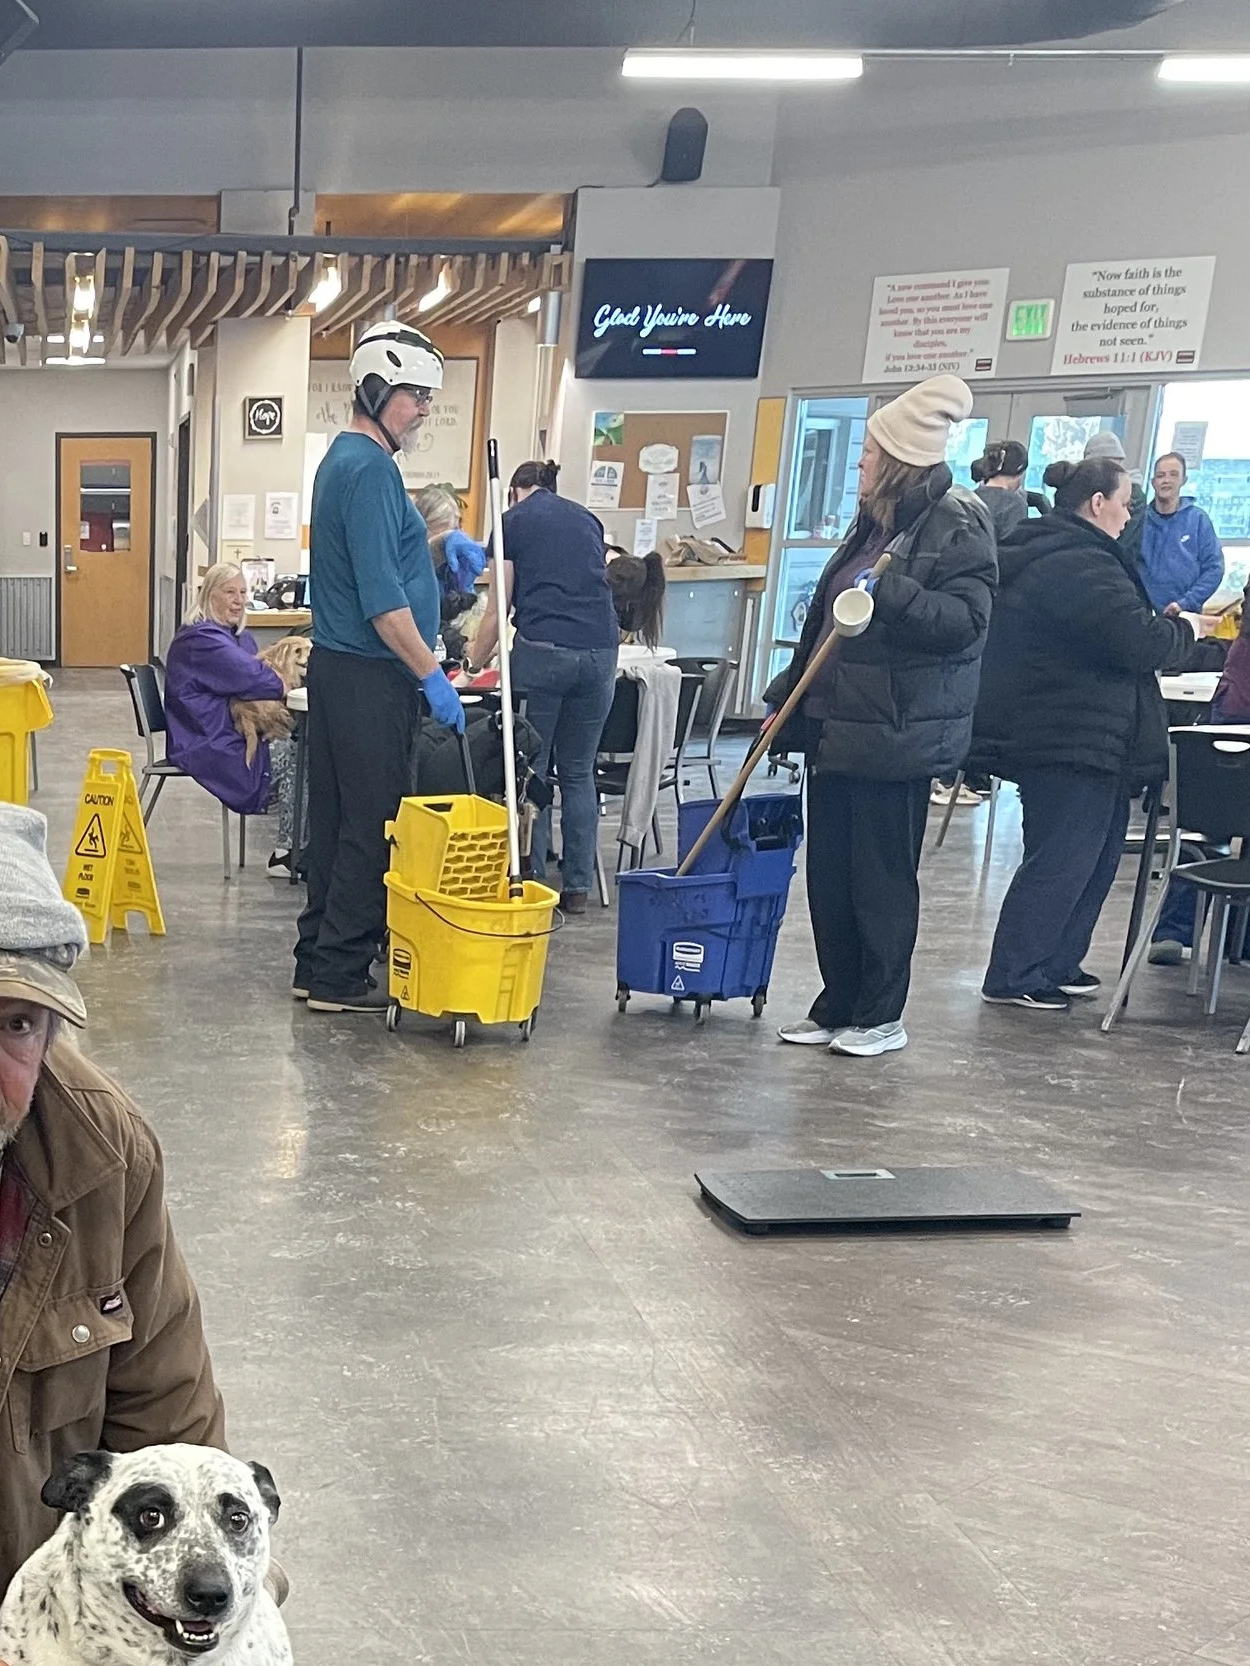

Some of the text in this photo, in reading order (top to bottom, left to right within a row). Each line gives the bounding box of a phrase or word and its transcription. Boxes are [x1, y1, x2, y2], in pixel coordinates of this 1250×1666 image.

[1124, 268, 1150, 280] faith
[1152, 267, 1161, 278] is
[1164, 266, 1183, 278] the
[1083, 284, 1187, 299] substance of things
[1103, 301, 1160, 316] hoped for,
[593, 303, 752, 338] Glad You're Here
[1071, 317, 1188, 332] the evidence of things
[1100, 336, 1117, 347] not
[1063, 350, 1173, 366] Hebrews 11:1 (KJV)
[84, 793, 115, 806] CAUTION
